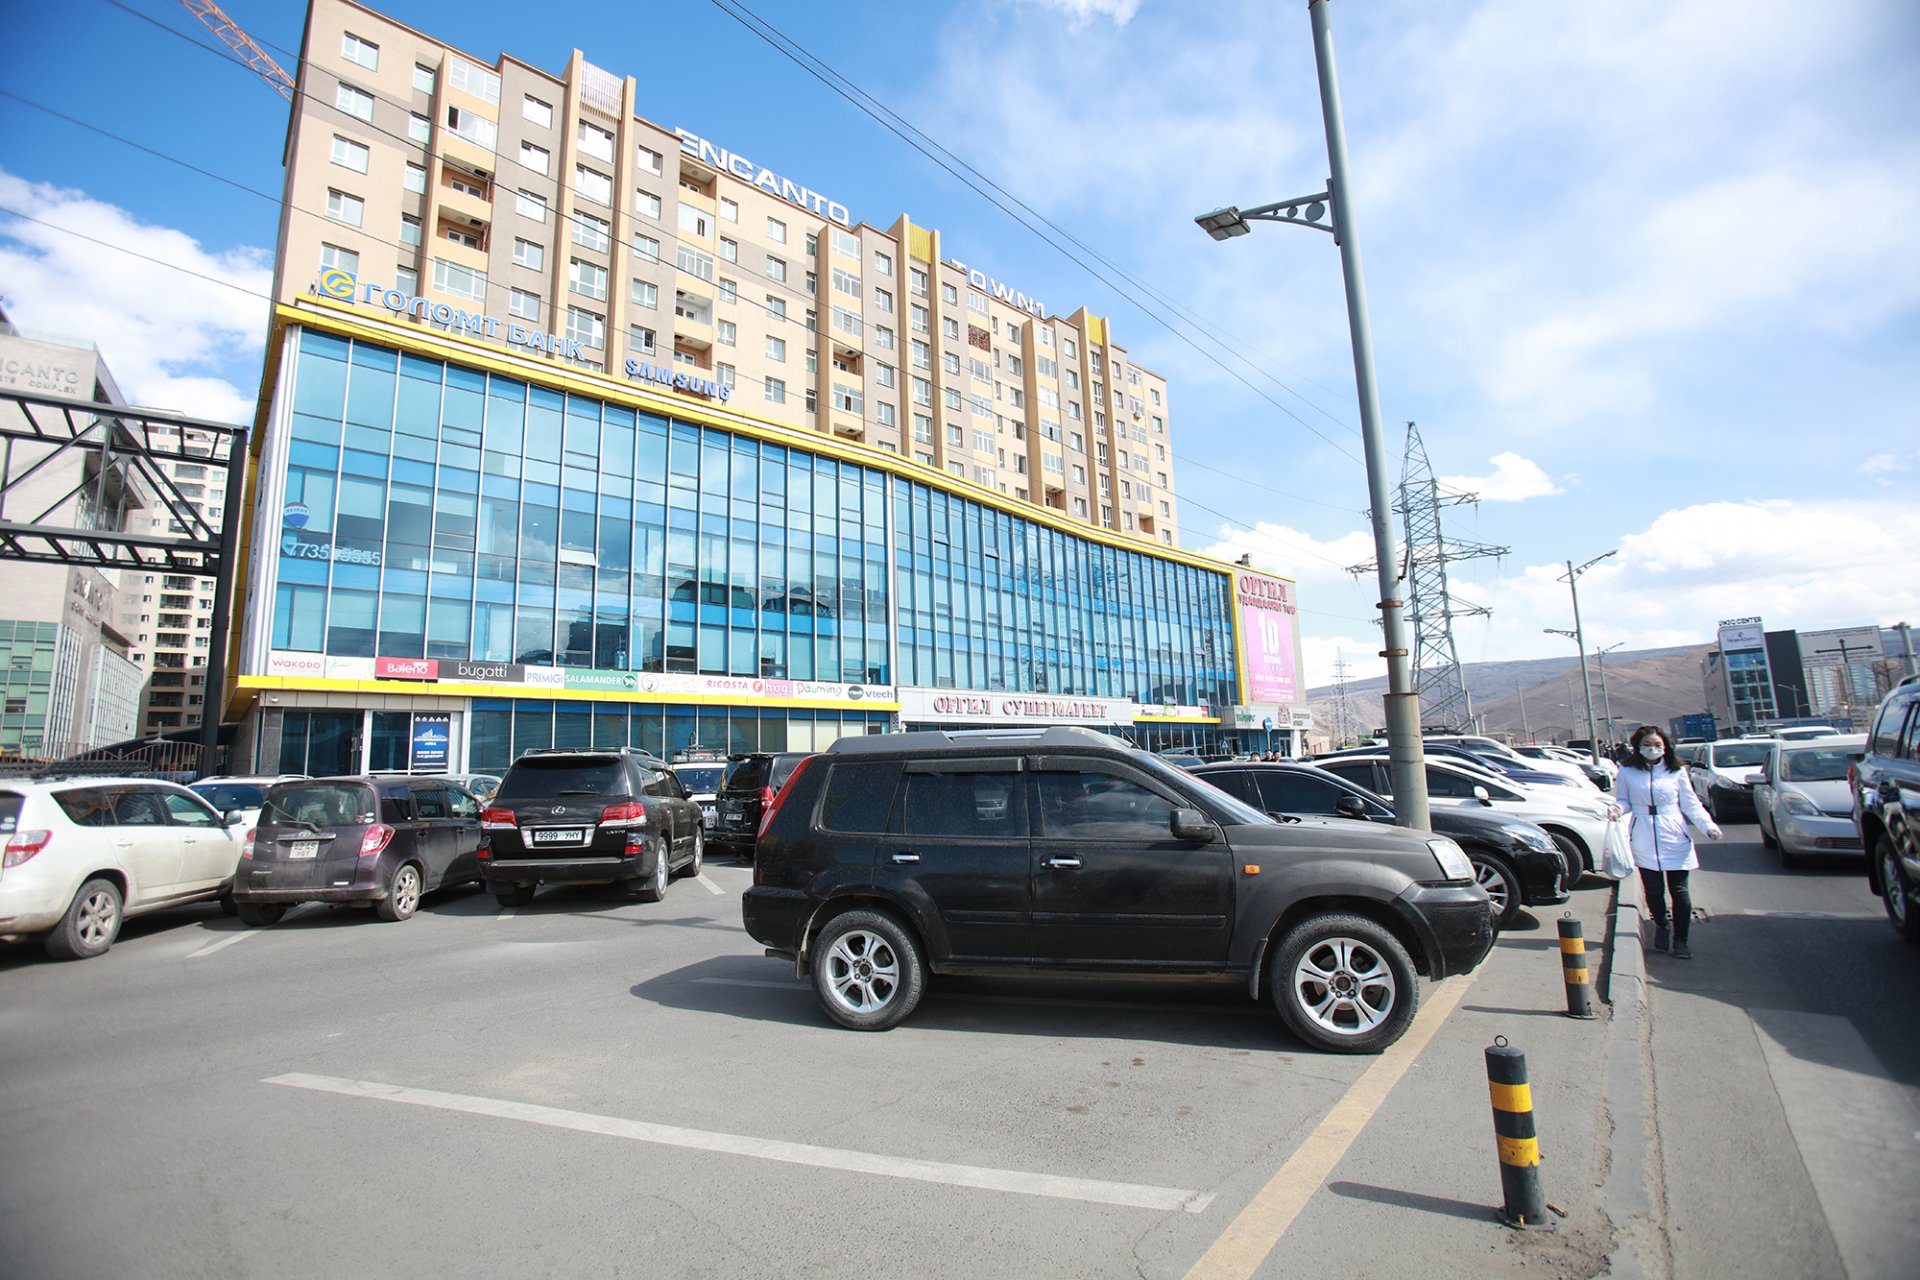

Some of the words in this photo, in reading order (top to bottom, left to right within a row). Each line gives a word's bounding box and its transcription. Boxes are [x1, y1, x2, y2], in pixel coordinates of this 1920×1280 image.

[674, 126, 850, 226] ENCANTO
[364, 282, 500, 337] ГОЛОМТ
[508, 323, 586, 361] БАНК
[0, 358, 80, 385] CANTO
[624, 358, 731, 401] SAMSUNG
[28, 380, 77, 394] COMPLEX
[1239, 574, 1288, 602] ОРГИЛ
[1257, 611, 1280, 655] 10
[387, 662, 428, 675] Baleno
[458, 662, 508, 680] bugatti
[526, 672, 563, 684] PRIMIGI
[564, 673, 622, 685] SALAMANDER
[706, 679, 749, 690] RICOSTA
[933, 696, 992, 715] ОРГИЛ
[1002, 700, 1108, 718] СУПЕРМАРКЕТ
[538, 831, 558, 841] 9999
